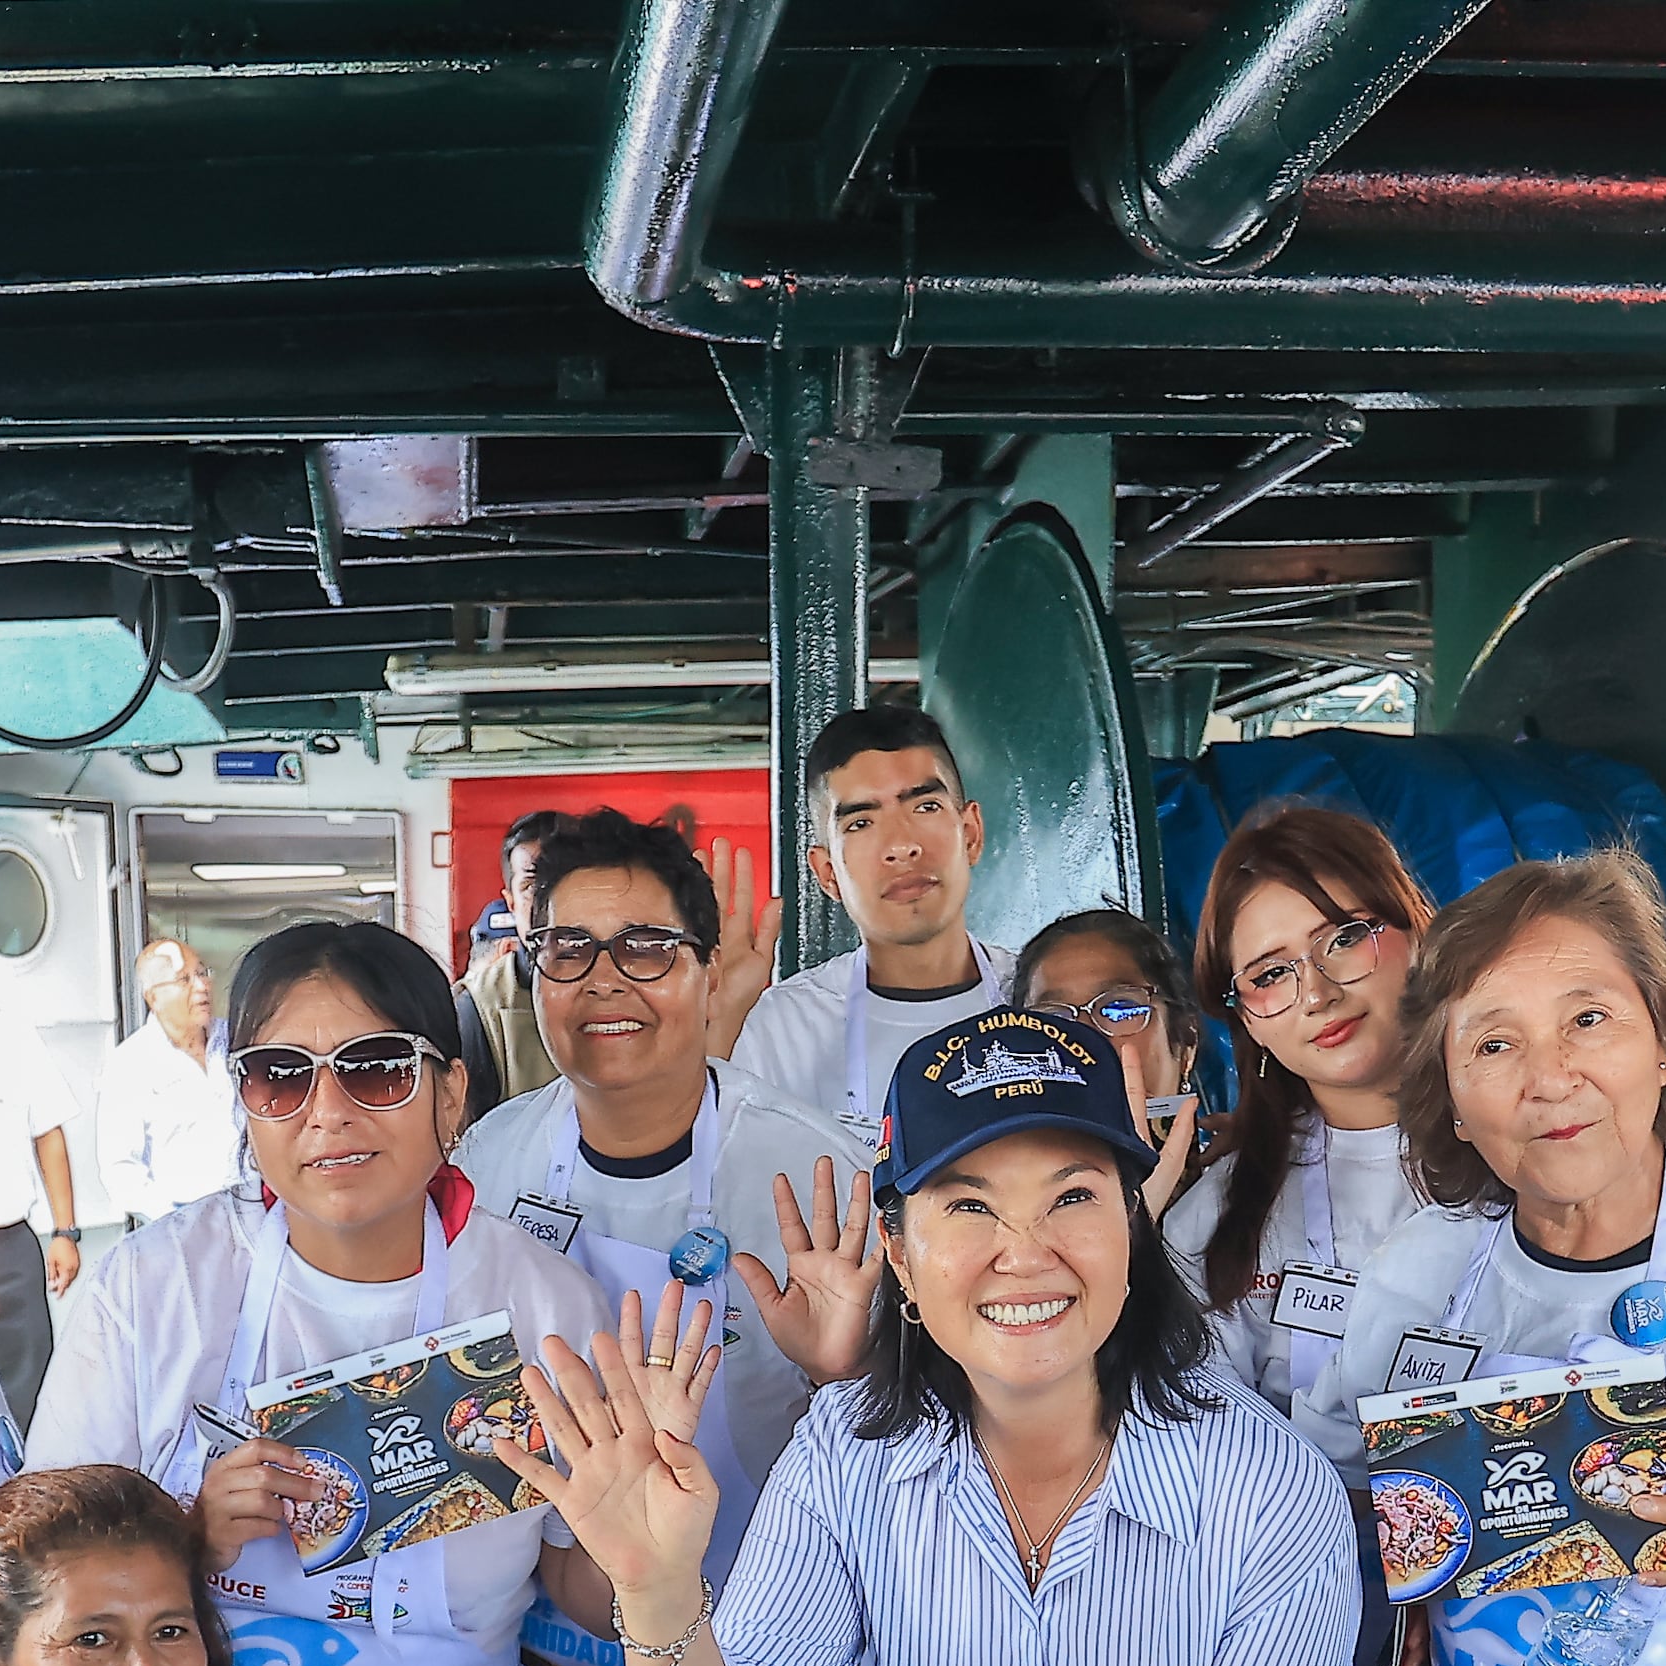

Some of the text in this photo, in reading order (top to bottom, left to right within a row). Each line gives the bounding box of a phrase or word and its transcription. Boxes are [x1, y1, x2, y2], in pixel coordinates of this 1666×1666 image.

[923, 1012, 1097, 1081] B.I.C. HUMBOLDT
[994, 1078, 1045, 1100] PERÚ
[370, 1440, 438, 1475] MAR
[373, 1461, 450, 1493] OPORTUNIDADES
[1482, 1480, 1558, 1511] MAR
[1479, 1506, 1569, 1531] OPORTUNIDADES
